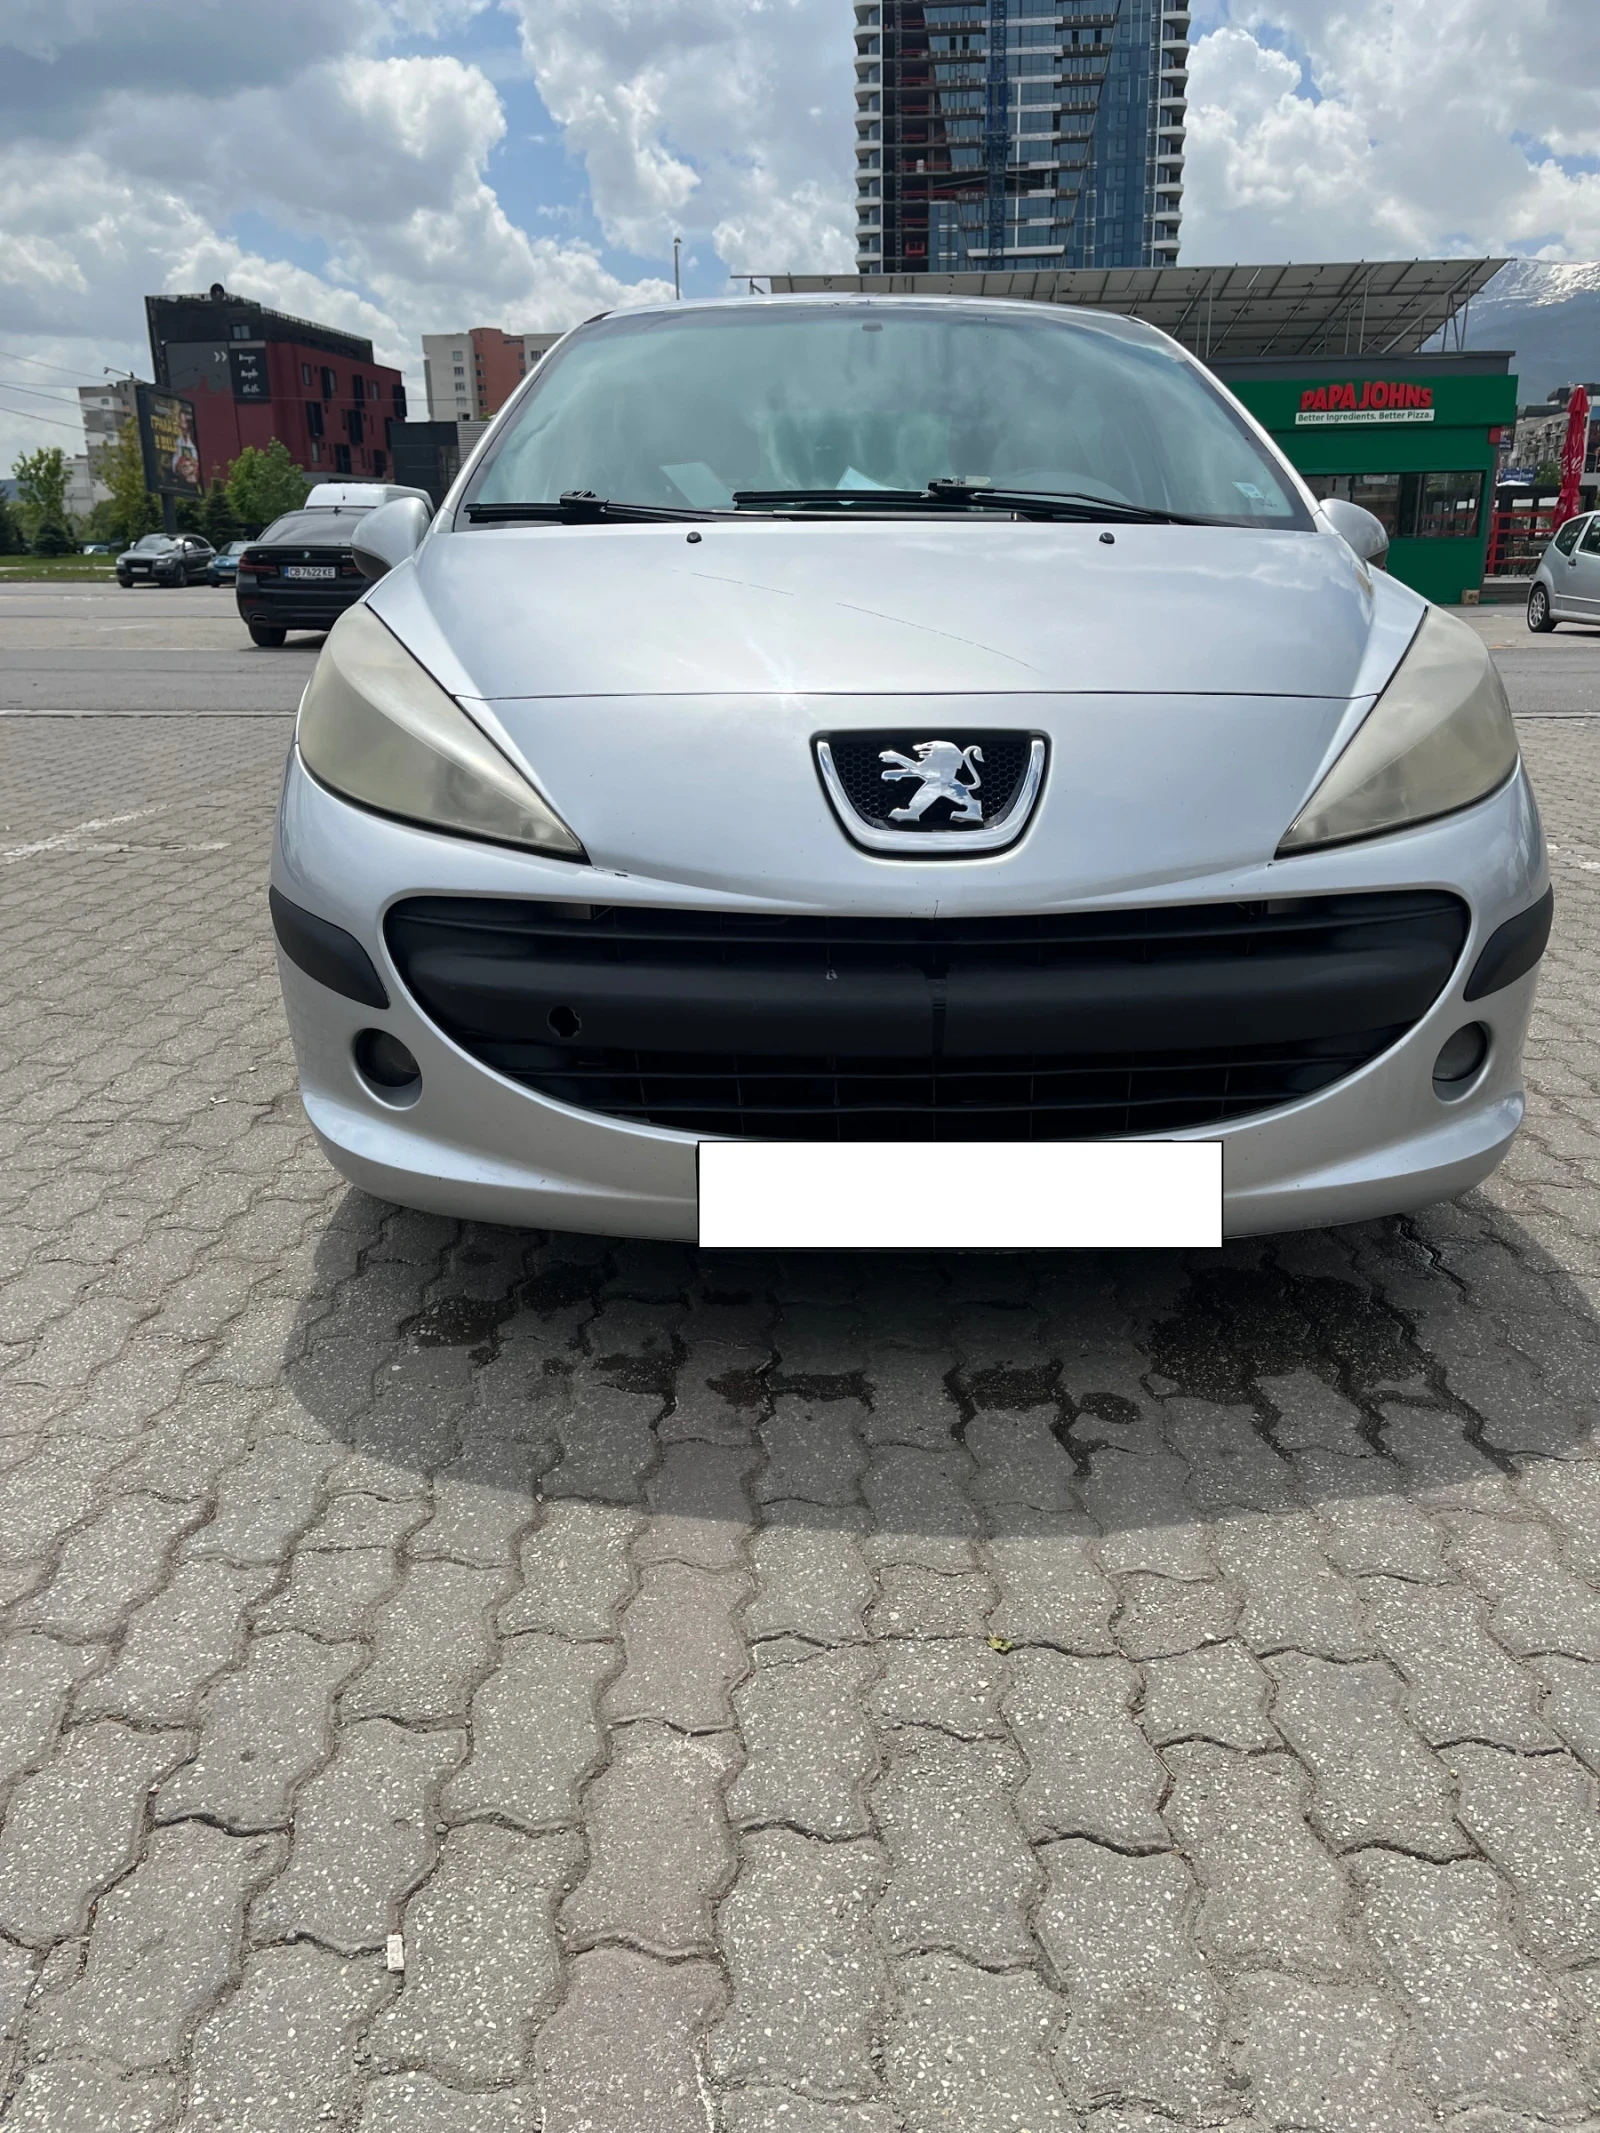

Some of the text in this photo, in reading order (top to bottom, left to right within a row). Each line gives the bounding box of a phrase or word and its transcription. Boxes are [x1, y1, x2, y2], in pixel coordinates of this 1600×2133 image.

[1301, 380, 1433, 410] PAPA JOHNS
[1298, 410, 1432, 423] Better Ingredients. Better Pizza.
